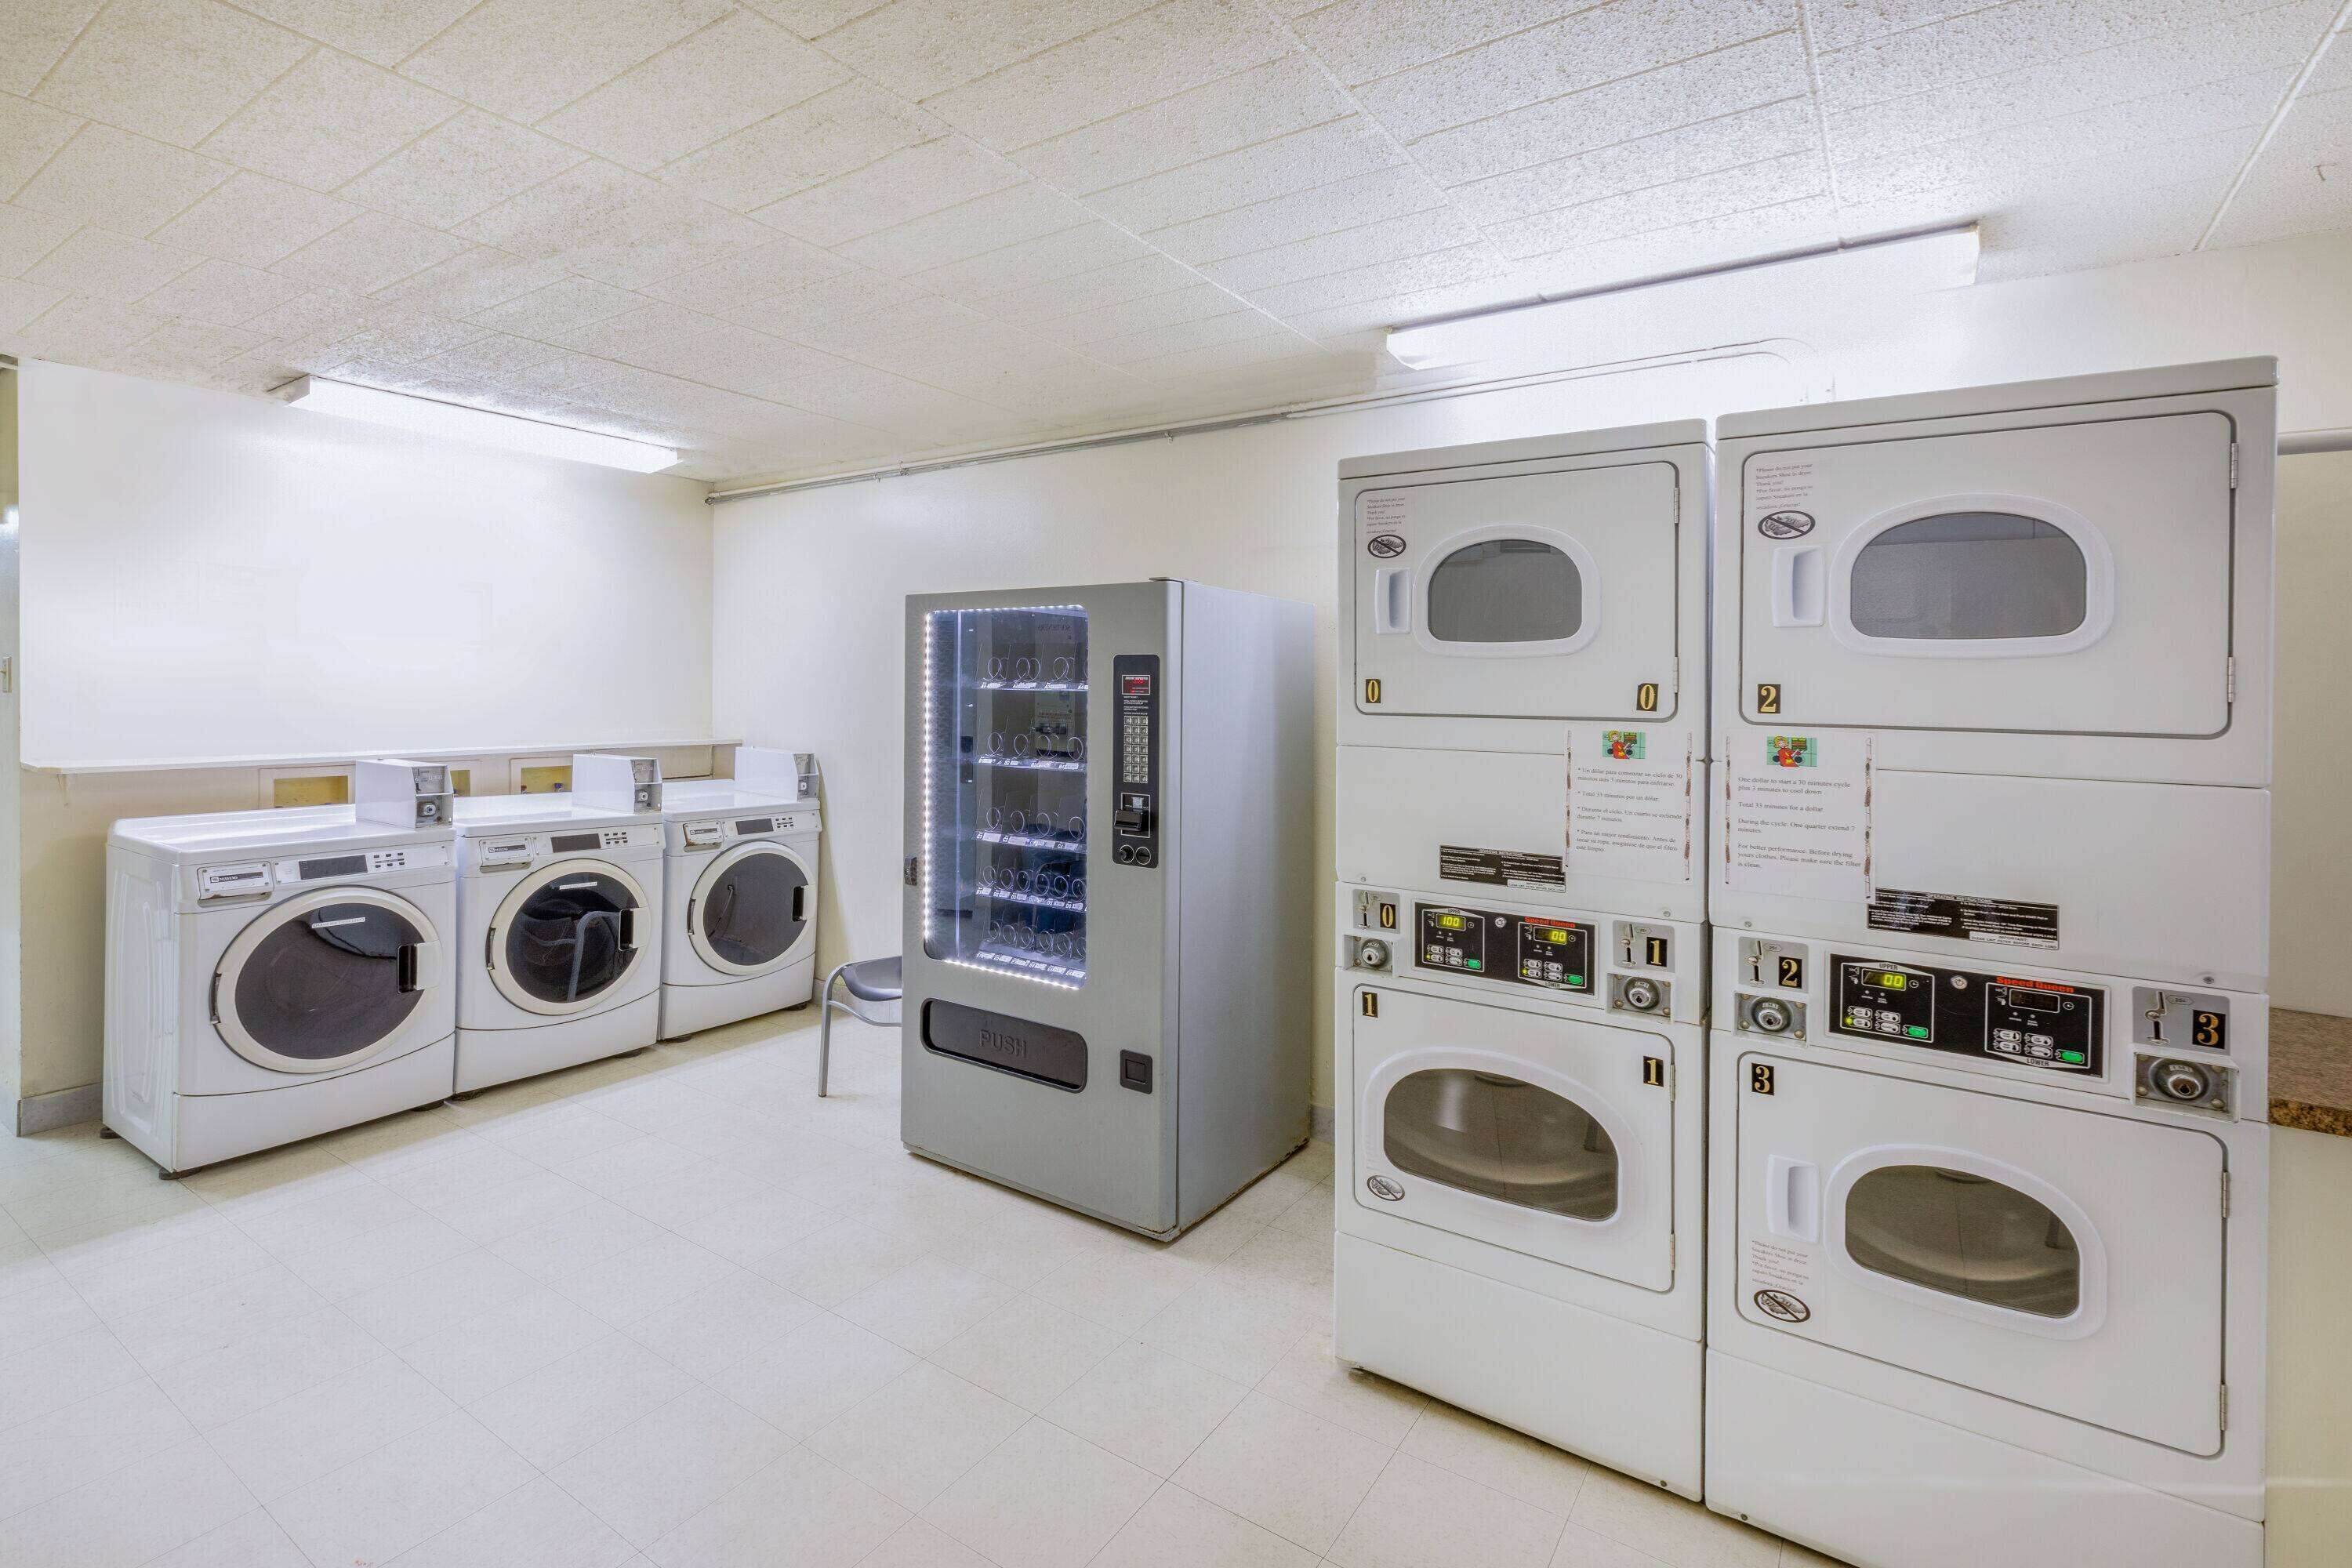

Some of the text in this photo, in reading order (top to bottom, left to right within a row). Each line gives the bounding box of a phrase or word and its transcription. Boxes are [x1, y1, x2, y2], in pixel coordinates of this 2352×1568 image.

[1368, 681, 1378, 702] 0
[1640, 684, 1655, 710] 0
[1760, 685, 1777, 713] 2
[1382, 905, 1393, 927] 0
[1443, 916, 1459, 926] 100
[1525, 916, 1575, 928] Speed Queen
[1650, 940, 1661, 965] 1
[1781, 959, 1798, 986] 2
[1996, 977, 2074, 993] Speed Queen
[1365, 994, 1374, 1016] 1
[2197, 1013, 2219, 1046] 3
[978, 1029, 1026, 1060] PUSH
[1647, 1059, 1658, 1084] 1
[2026, 1058, 2049, 1067] LOWER
[1755, 1065, 1770, 1093] 3
